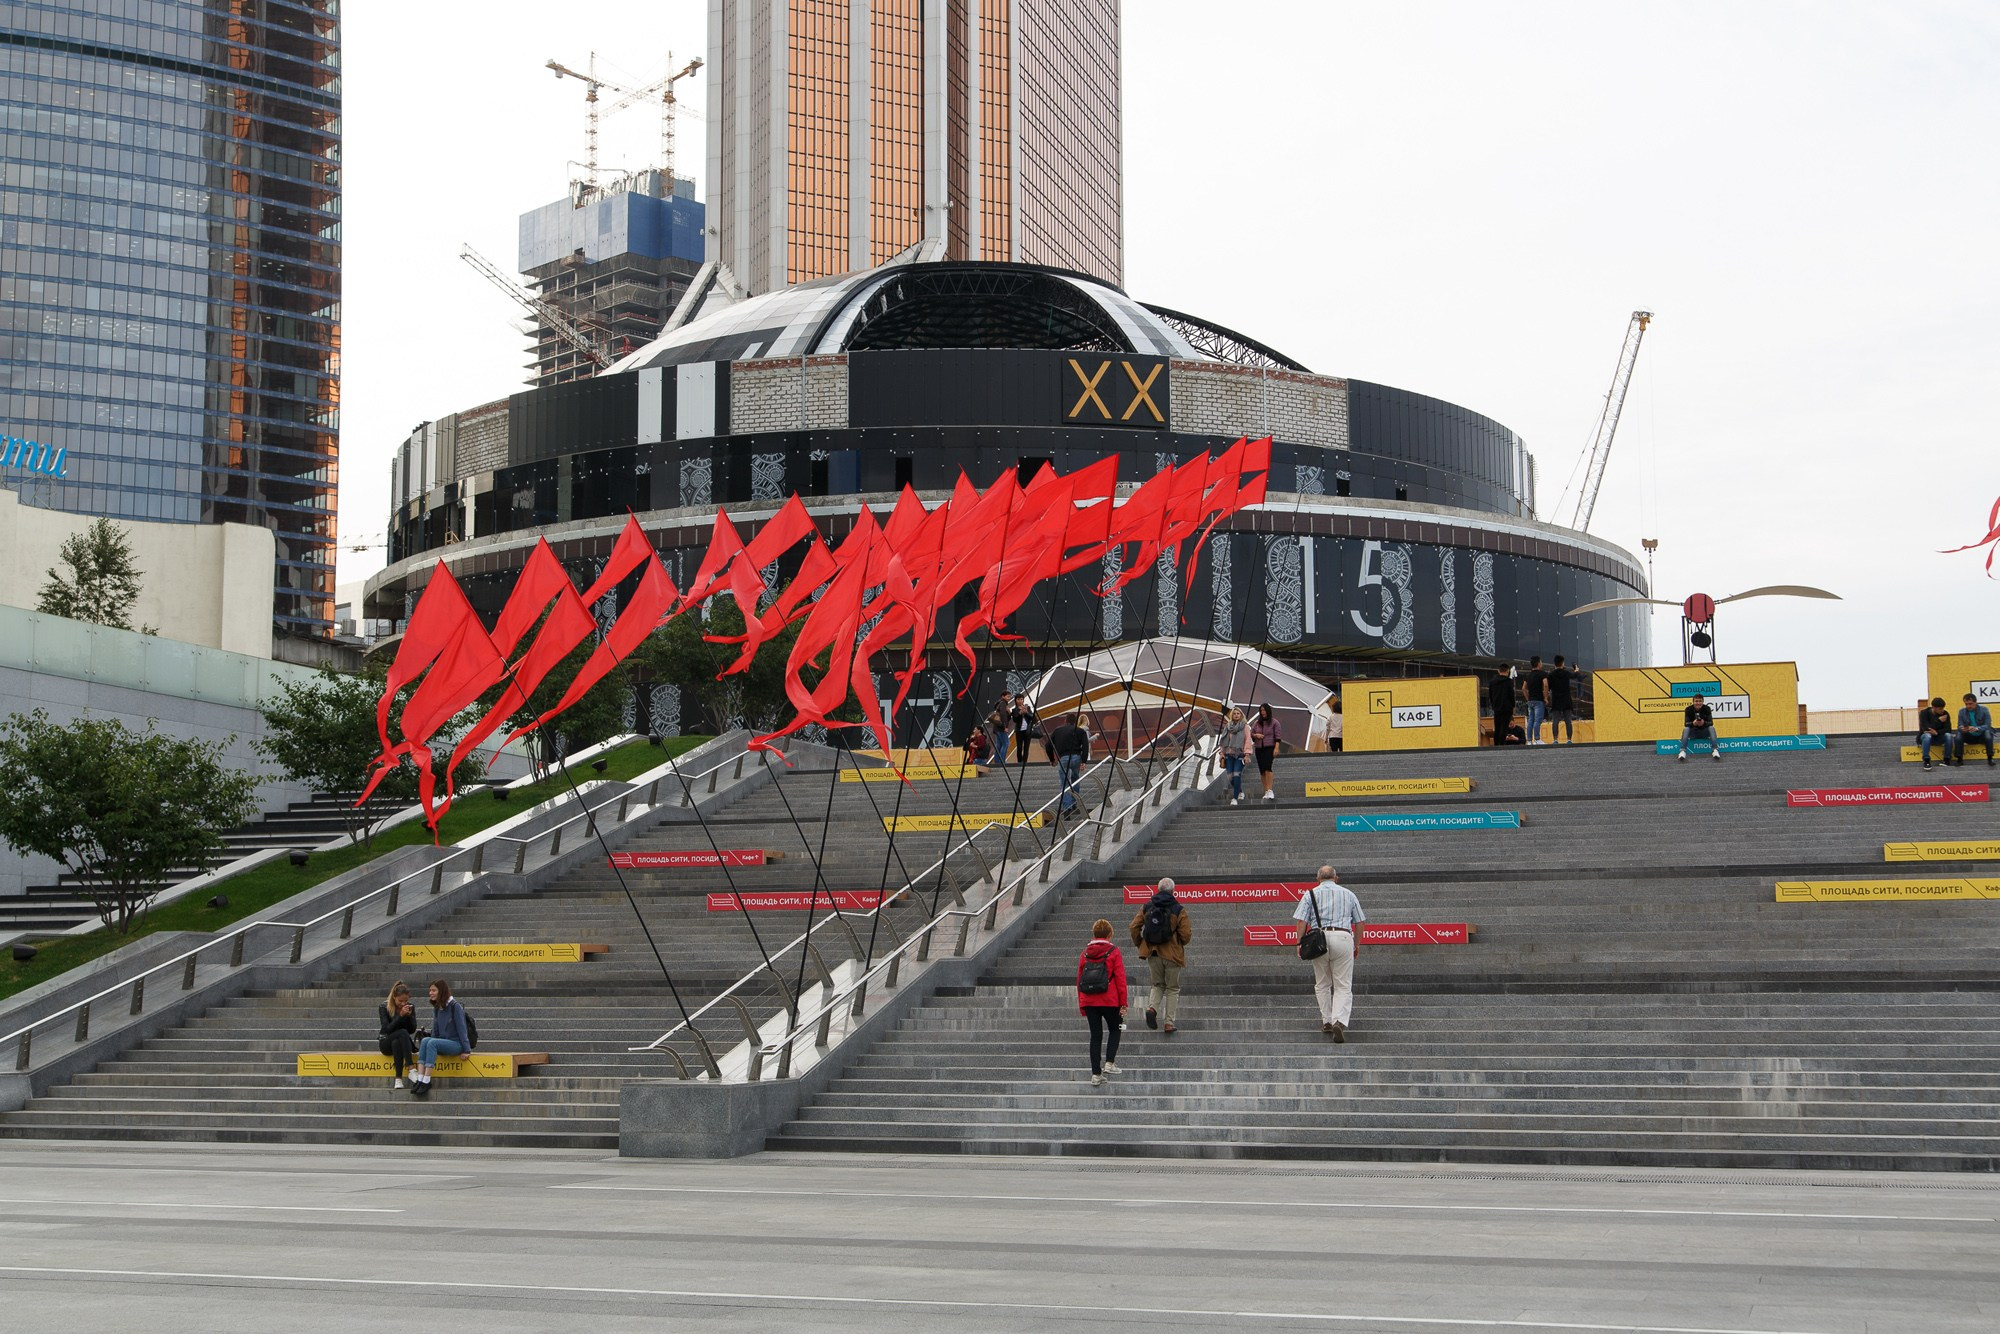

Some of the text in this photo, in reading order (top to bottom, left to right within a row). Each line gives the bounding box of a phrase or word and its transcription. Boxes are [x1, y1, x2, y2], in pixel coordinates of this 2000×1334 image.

[1676, 686, 1716, 694] ПЛОЩАДЬ
[1979, 687, 2000, 697] КА
[1706, 701, 1743, 712] СИТИ
[1398, 711, 1433, 722] КАФЕ
[1730, 741, 1751, 749] СИТИ,
[1752, 739, 1793, 748] ПОСИДИТЕ!
[1376, 784, 1397, 792] СИТИ,
[1868, 793, 1893, 801] СИТИ,
[1895, 791, 1943, 799] ПОСИДИТЕ!
[1377, 817, 1484, 827] ПЛОЩАДЬ СИТИ, ПОСИДИТЕ!
[1927, 847, 1974, 855] ПЛОЩАДЬ
[1173, 889, 1280, 898] ОЩАДЬ СИТИ, ПОСИДИТЕ!
[1820, 886, 1963, 896] ПЛОЩАДЬ СИТИ, ПОСИДИТЕ!
[779, 897, 802, 905] СИТИ,
[1363, 930, 1416, 939] ПОСИДИТЕ!
[1436, 929, 1454, 938] Кафе
[440, 950, 477, 958] ПЛОЩАДЬ
[502, 949, 545, 957] ПОСИДИТЕ!
[337, 1062, 381, 1071] ПЛОЩАДЬ
[483, 1062, 500, 1070] Кафе
